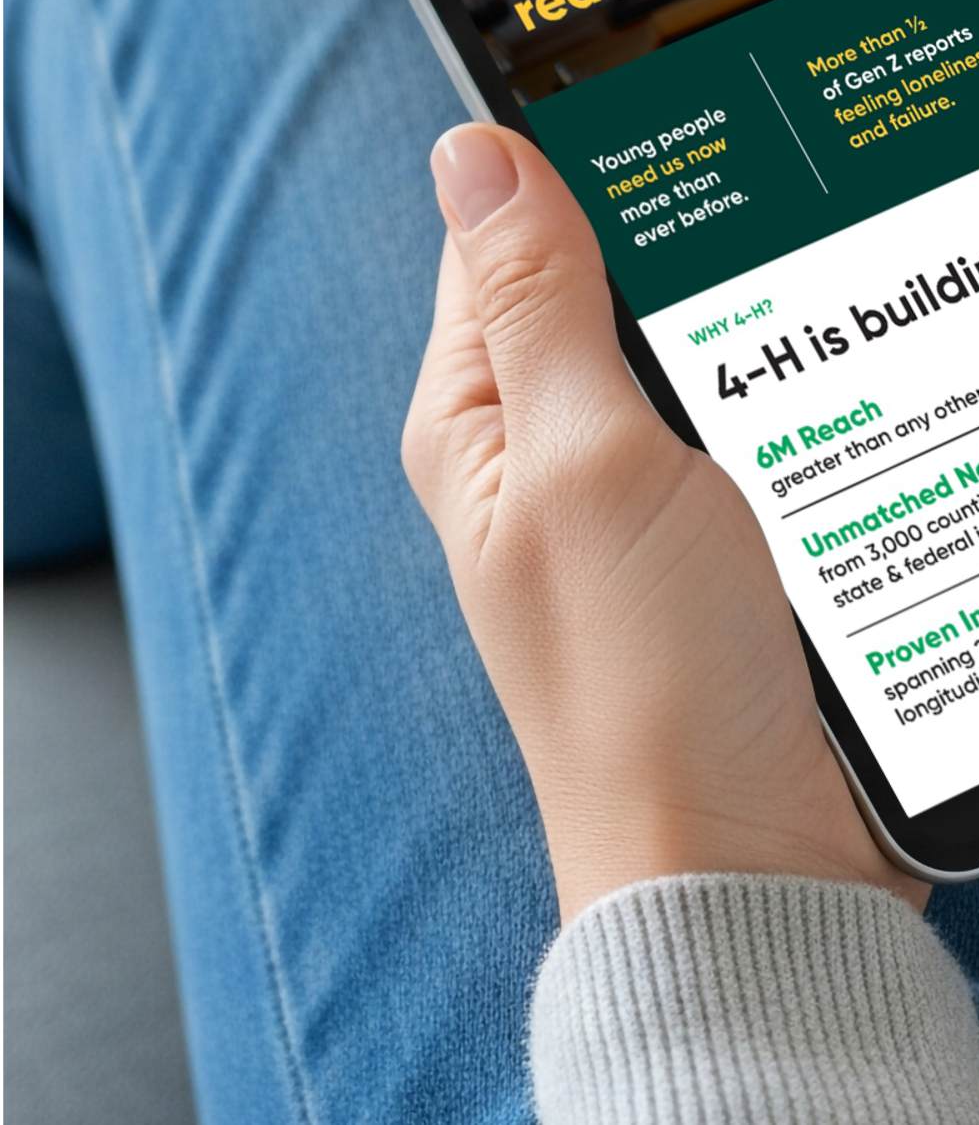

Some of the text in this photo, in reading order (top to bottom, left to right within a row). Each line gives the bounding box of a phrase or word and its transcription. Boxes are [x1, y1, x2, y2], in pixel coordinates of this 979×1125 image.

[807, 48, 857, 77] More
[859, 28, 906, 54] than
[823, 28, 973, 100] of Gen Z reports
[835, 88, 903, 124] feeling
[850, 97, 956, 148] and failure.
[591, 110, 726, 173] Young people
[607, 138, 726, 199] need us now
[620, 172, 721, 223] more than
[635, 192, 749, 247] ever before.
[688, 299, 773, 346] WHY 4-H?
[717, 336, 805, 400] 4-H
[803, 325, 849, 362] is
[757, 400, 883, 469] 6M Reach
[771, 453, 842, 498] greater
[845, 432, 892, 459] than
[895, 413, 930, 437] any
[801, 474, 954, 557] Unmatched
[819, 555, 866, 583] from
[864, 524, 923, 561] 3,000
[833, 577, 883, 608] state
[886, 565, 903, 583] &
[904, 530, 974, 574] federal
[865, 623, 960, 676] Proven
[884, 650, 975, 700] spanning
